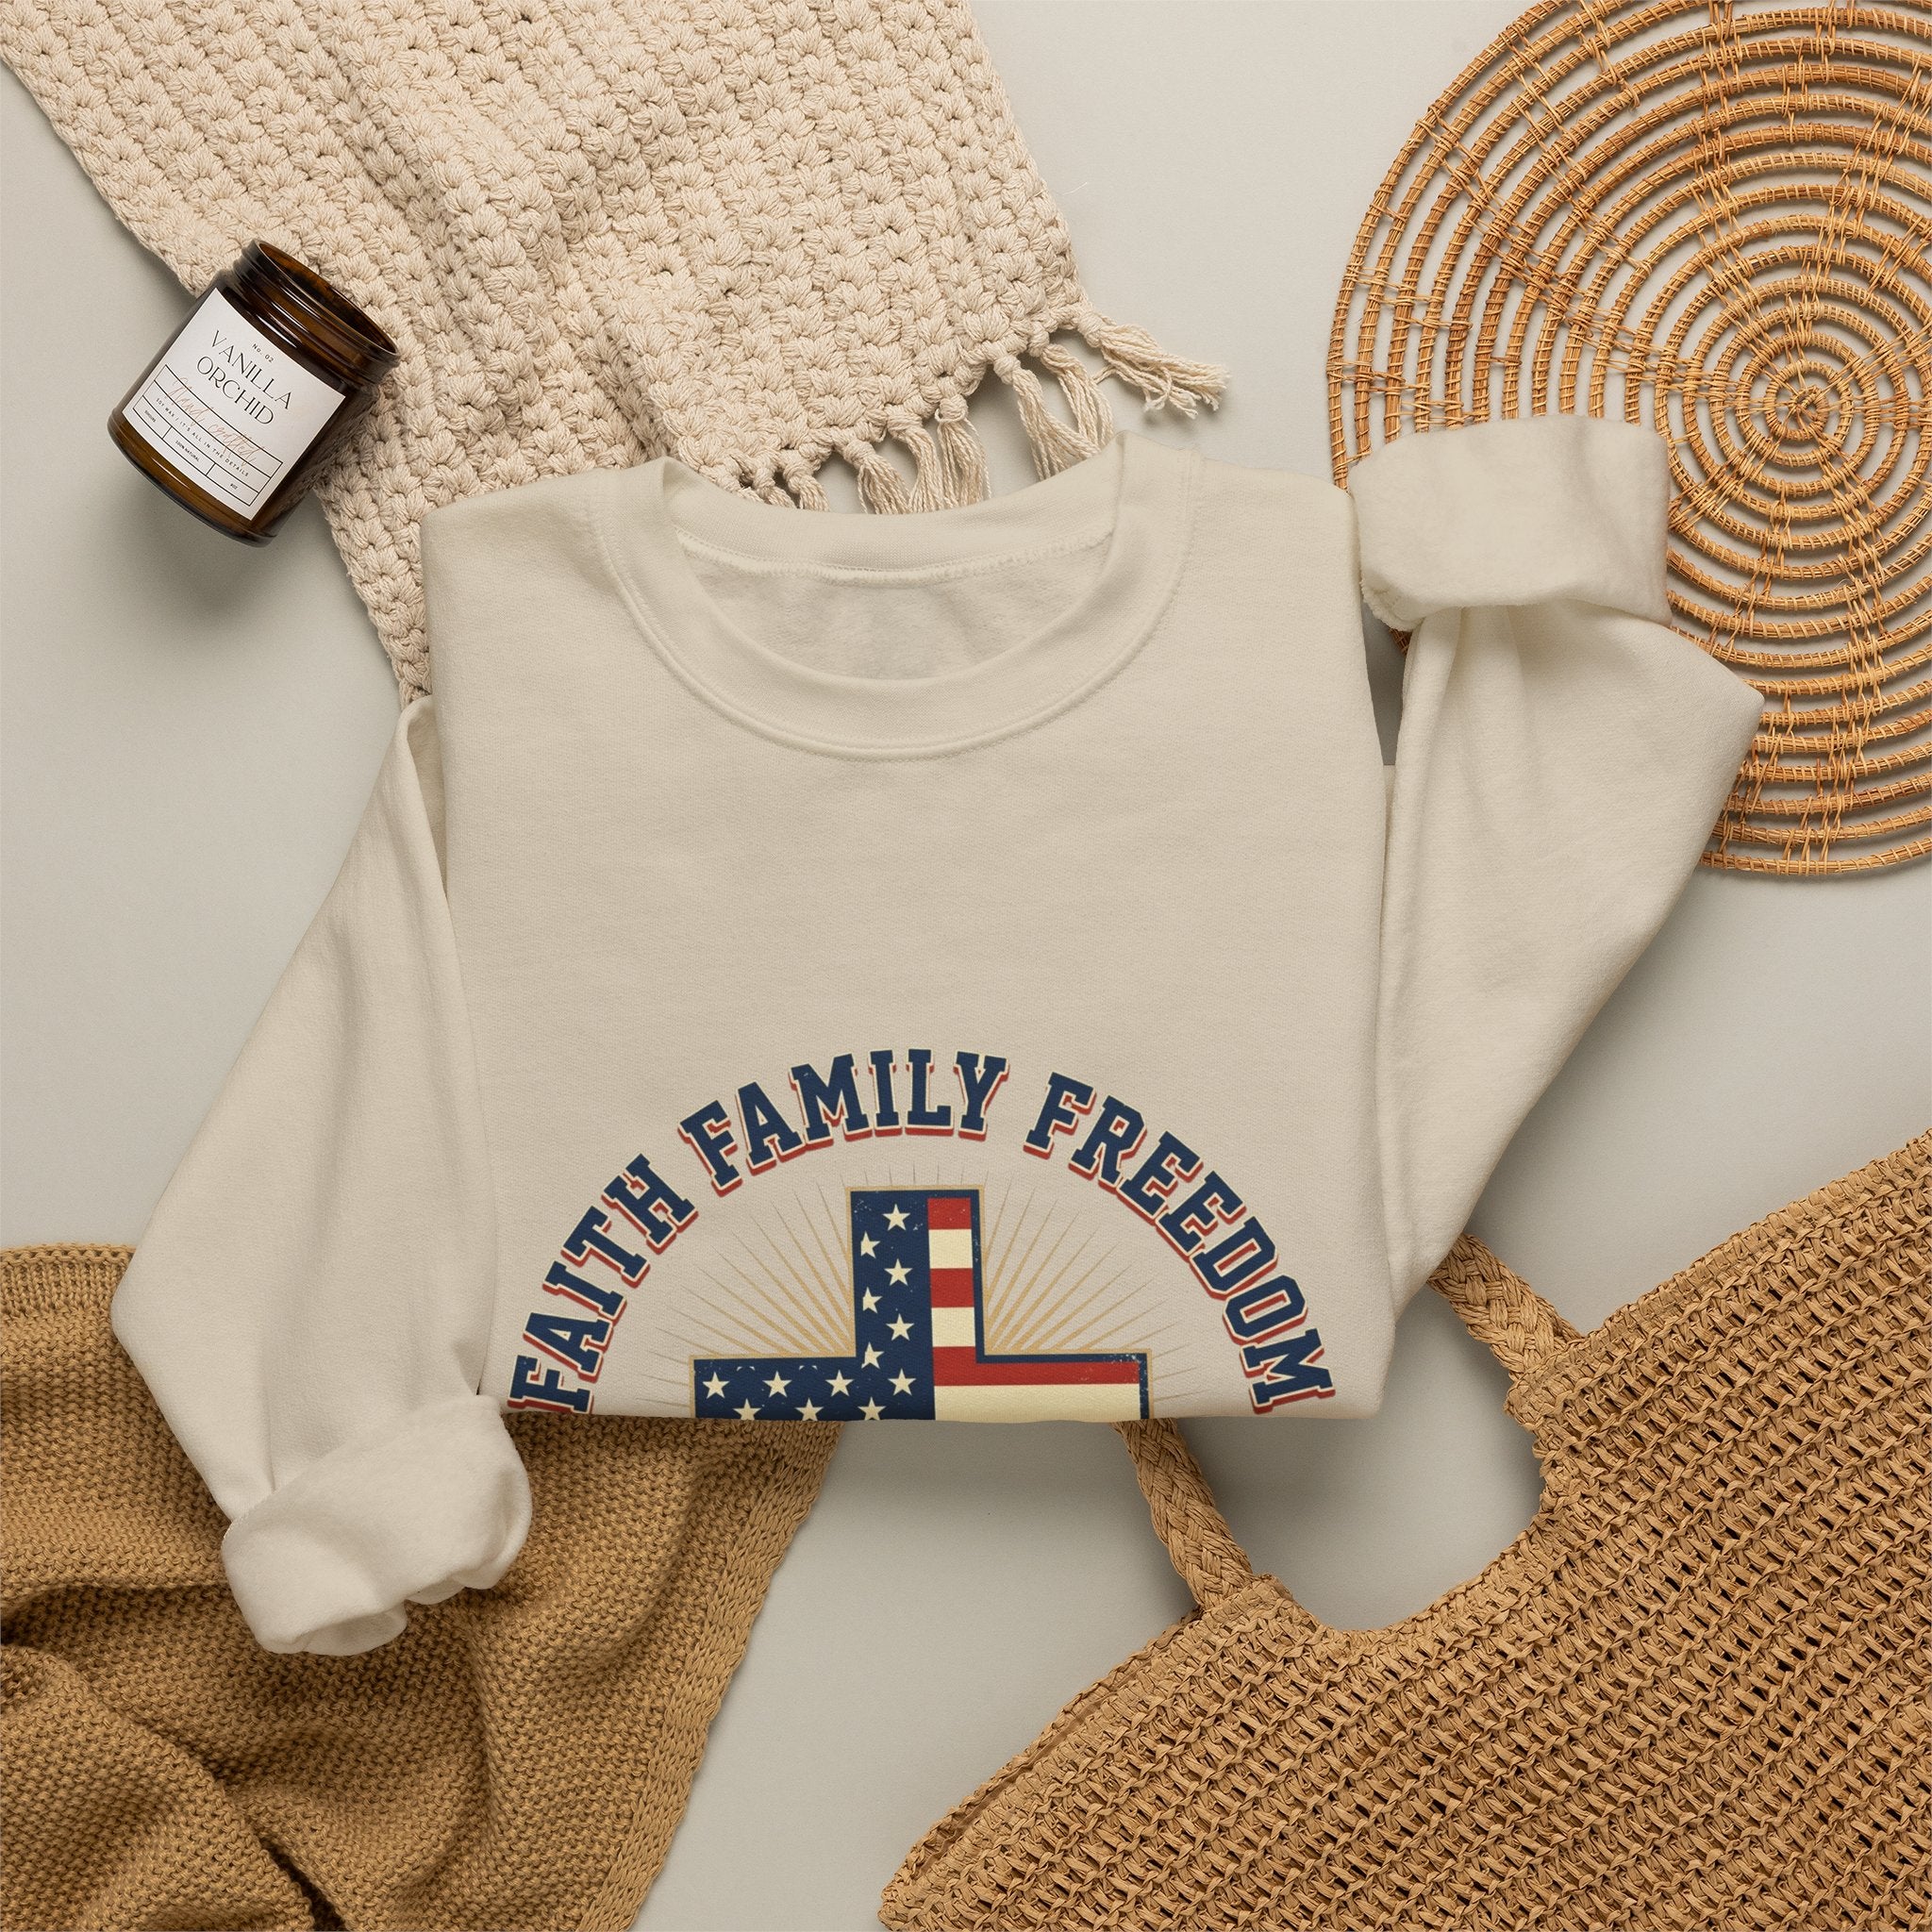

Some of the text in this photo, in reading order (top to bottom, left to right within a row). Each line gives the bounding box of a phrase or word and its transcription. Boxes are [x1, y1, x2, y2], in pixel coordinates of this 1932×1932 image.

[211, 329, 291, 409] VANILLA
[251, 343, 275, 364] No. 02
[196, 356, 275, 425] ORCHID
[192, 432, 202, 442] ALL
[212, 448, 224, 458] THE
[225, 458, 249, 477] DETAILS
[508, 1048, 1337, 1415] FAITH FAMILY FREEDOM
